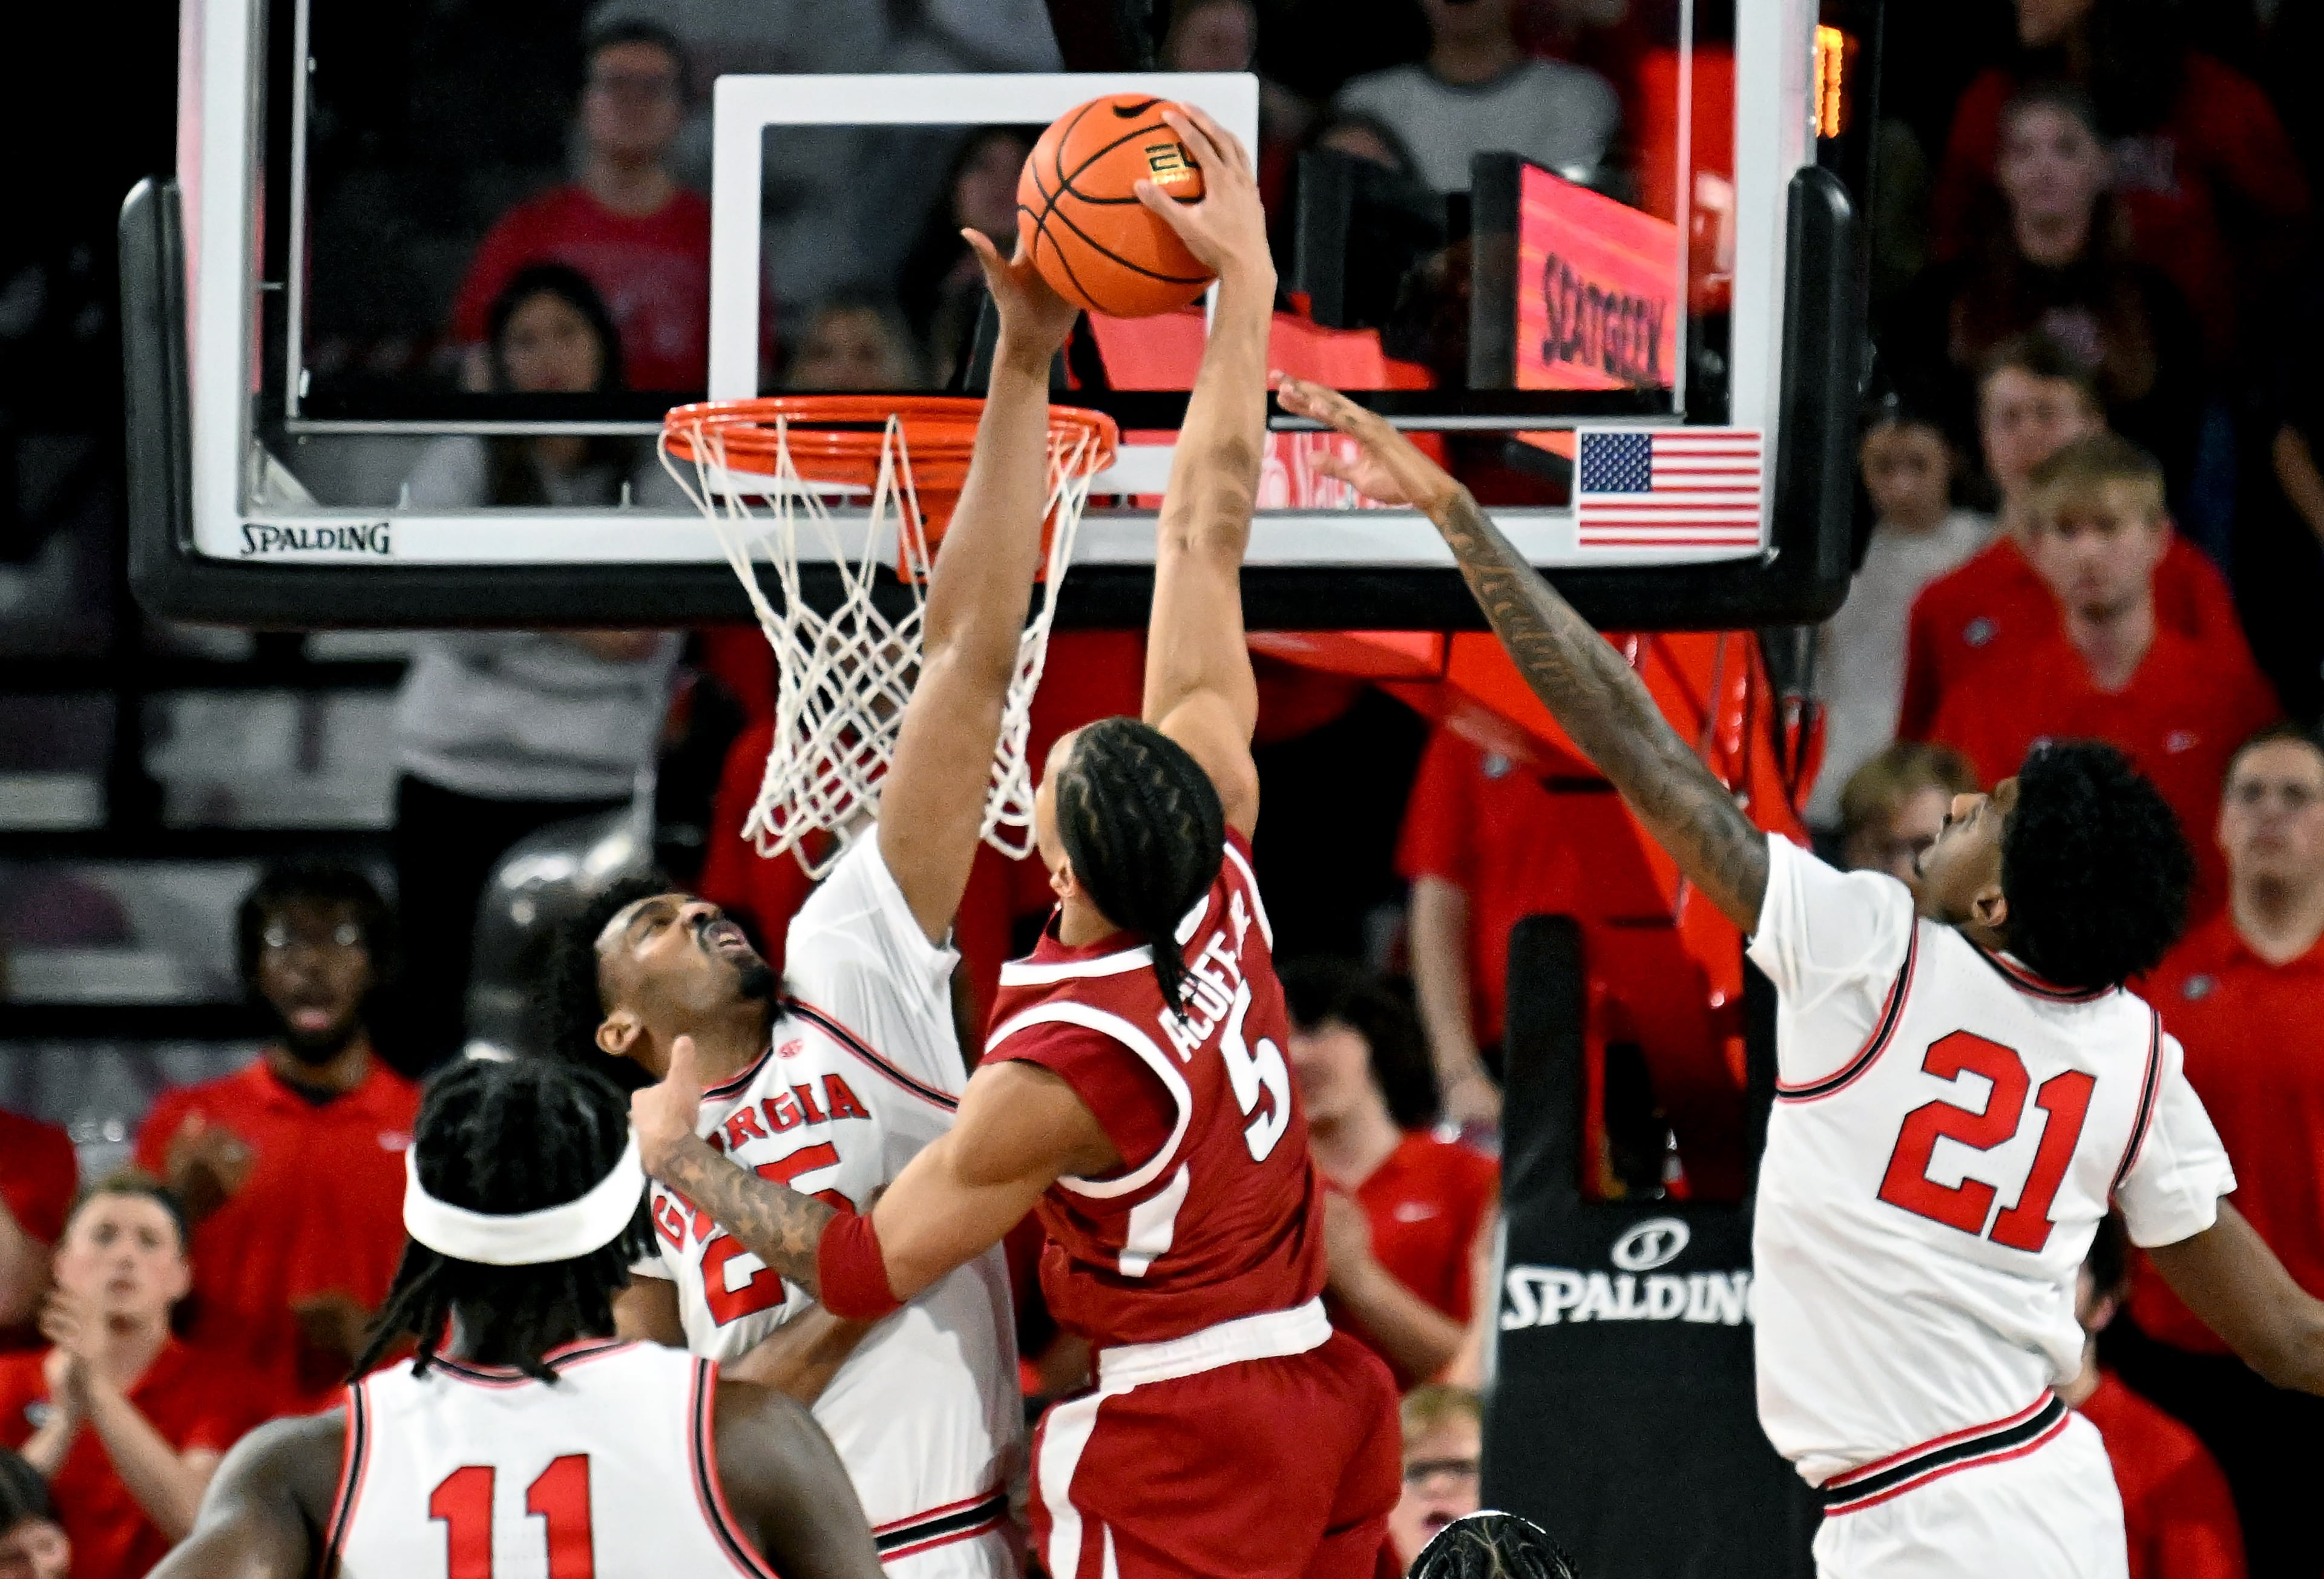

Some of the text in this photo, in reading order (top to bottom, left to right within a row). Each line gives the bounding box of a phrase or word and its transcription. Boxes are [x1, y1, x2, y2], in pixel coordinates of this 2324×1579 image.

[241, 522, 390, 554] SPALDING
[1219, 977, 1291, 1162] 5
[1876, 1029, 2097, 1254] 21
[652, 1073, 872, 1254] GRGIA
[1501, 1264, 1756, 1330] SPALDIN
[427, 1453, 597, 1579] 11
